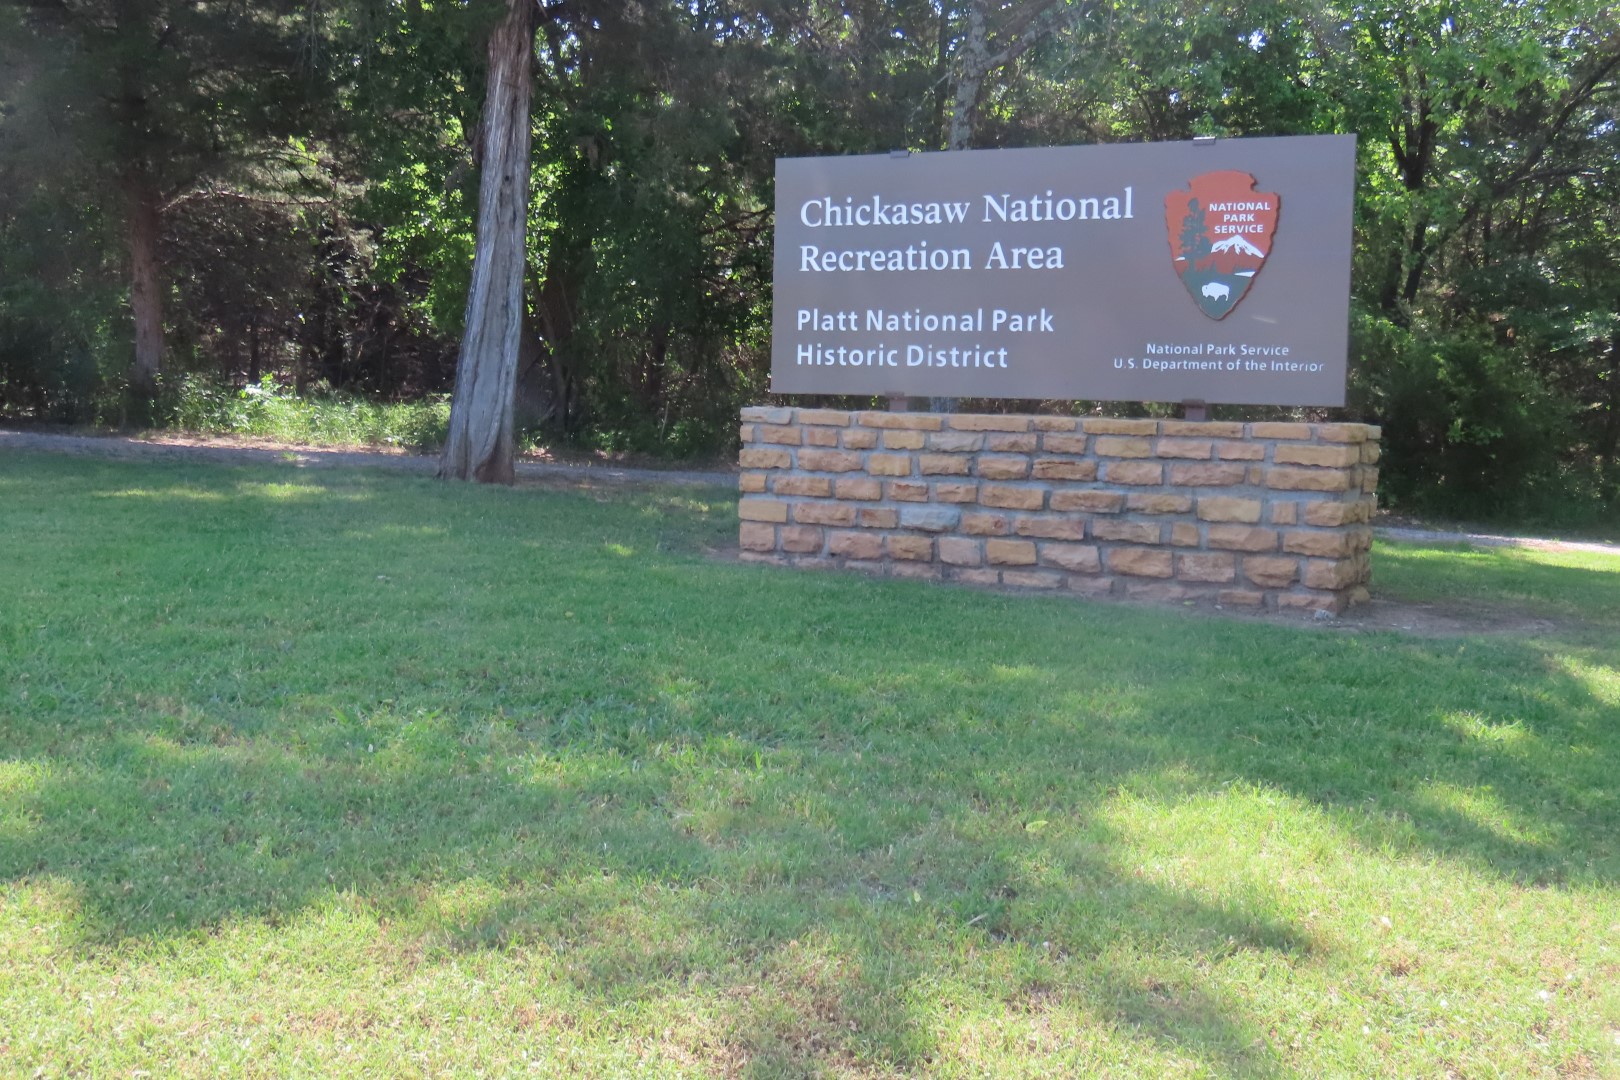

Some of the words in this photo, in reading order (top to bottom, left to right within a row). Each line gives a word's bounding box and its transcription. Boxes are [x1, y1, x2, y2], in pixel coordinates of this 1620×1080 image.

[800, 195, 970, 227] Chickasaw
[982, 186, 1134, 223] National
[1209, 202, 1271, 212] NATIONAL
[1223, 213, 1254, 222] PARK
[1214, 224, 1264, 234] SERVICE
[799, 241, 972, 272] Recreation
[985, 242, 1064, 270] Area
[797, 308, 858, 332] Platt
[866, 308, 983, 332] National
[992, 308, 1054, 332] Park
[797, 343, 898, 366] Historic
[906, 344, 1008, 368] District
[1146, 343, 1202, 355] National
[1207, 344, 1236, 355] Park
[1240, 344, 1289, 355] Service
[1114, 358, 1138, 370] U.S.
[1142, 359, 1223, 372] Department
[1226, 359, 1241, 371] of
[1245, 359, 1267, 371] the
[1271, 360, 1325, 372] Interior
